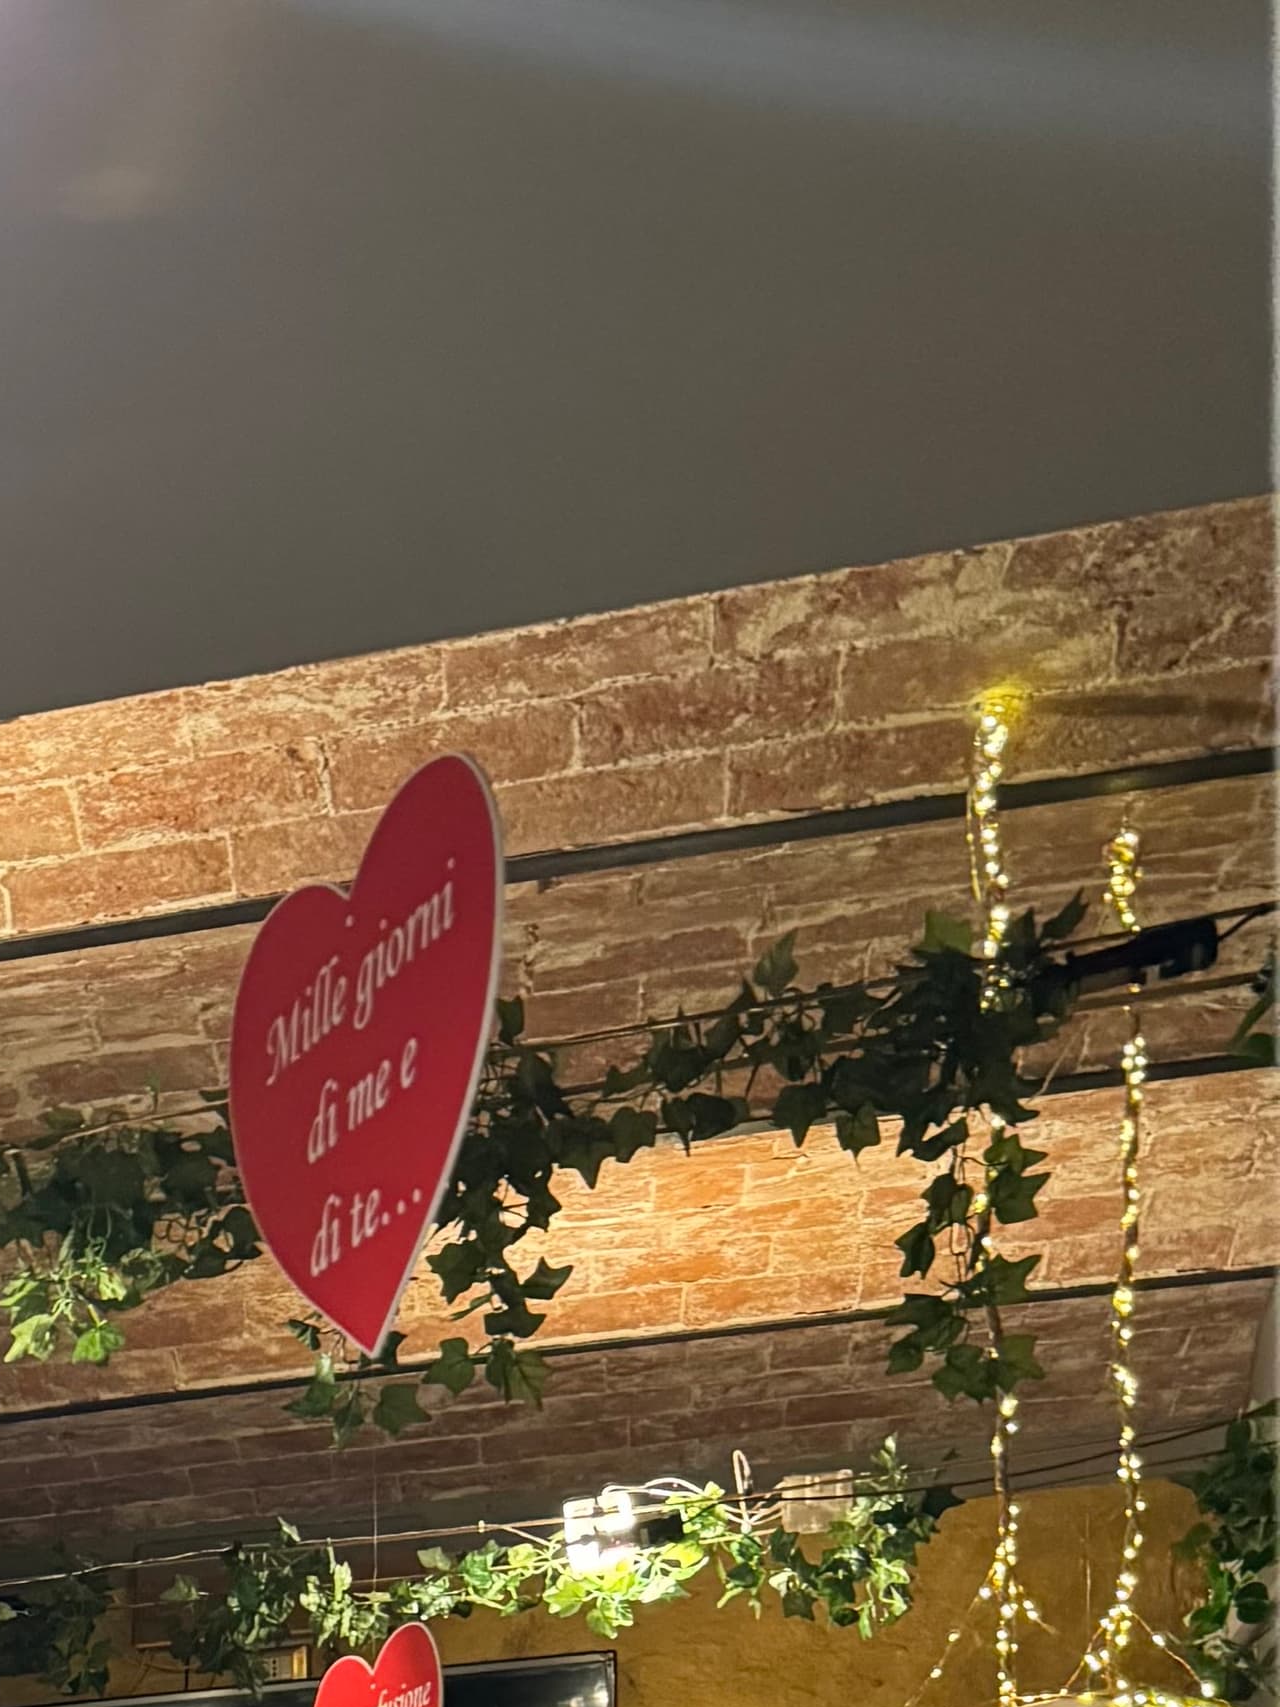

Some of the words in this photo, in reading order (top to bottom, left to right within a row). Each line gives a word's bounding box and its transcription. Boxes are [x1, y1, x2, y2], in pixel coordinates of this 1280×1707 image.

[266, 956, 346, 1086] Mille
[352, 858, 456, 1031] giorni
[307, 1080, 337, 1166] di
[348, 1055, 391, 1132] me
[401, 1037, 417, 1090] e
[310, 1193, 340, 1279] di
